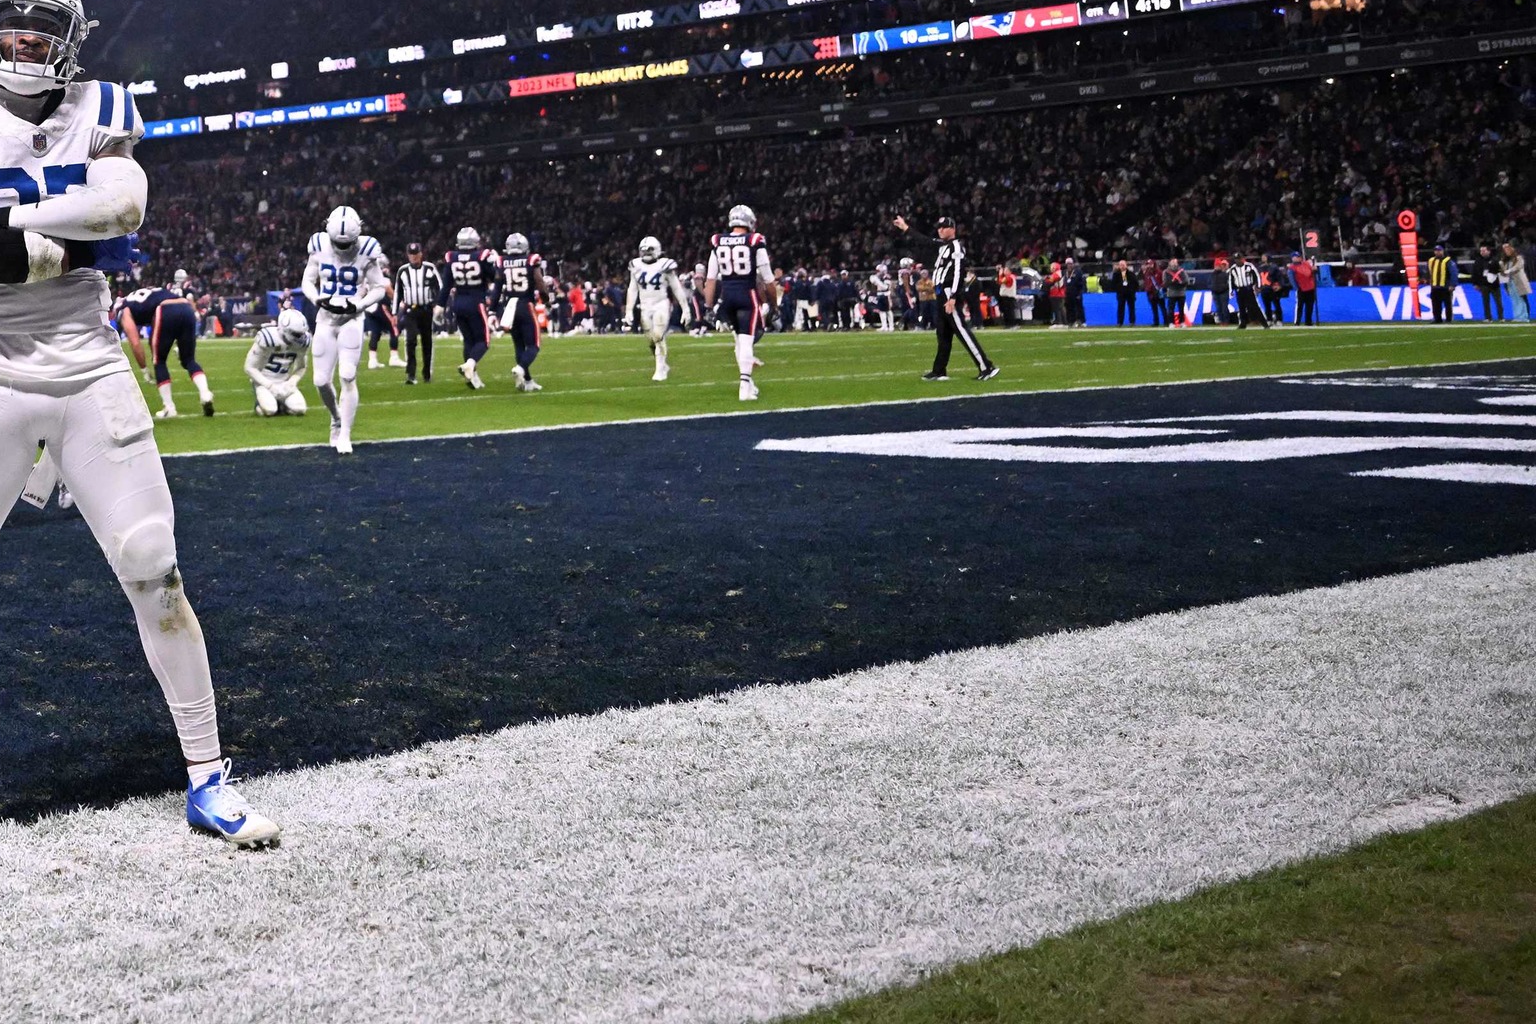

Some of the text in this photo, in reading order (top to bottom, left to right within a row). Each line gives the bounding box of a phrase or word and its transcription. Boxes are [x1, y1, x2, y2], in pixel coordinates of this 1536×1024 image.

[1024, 13, 1035, 28] 6
[1108, 2, 1119, 17] 4
[900, 30, 918, 45] 10
[516, 59, 690, 93] 2023 NFL FRANKFURT GAMES
[1305, 231, 1319, 248] 2
[716, 245, 752, 276] 88
[320, 263, 359, 296] 38
[451, 261, 482, 285] 62
[504, 267, 529, 292] 15
[637, 271, 662, 291] 44
[1361, 286, 1474, 321] VISA
